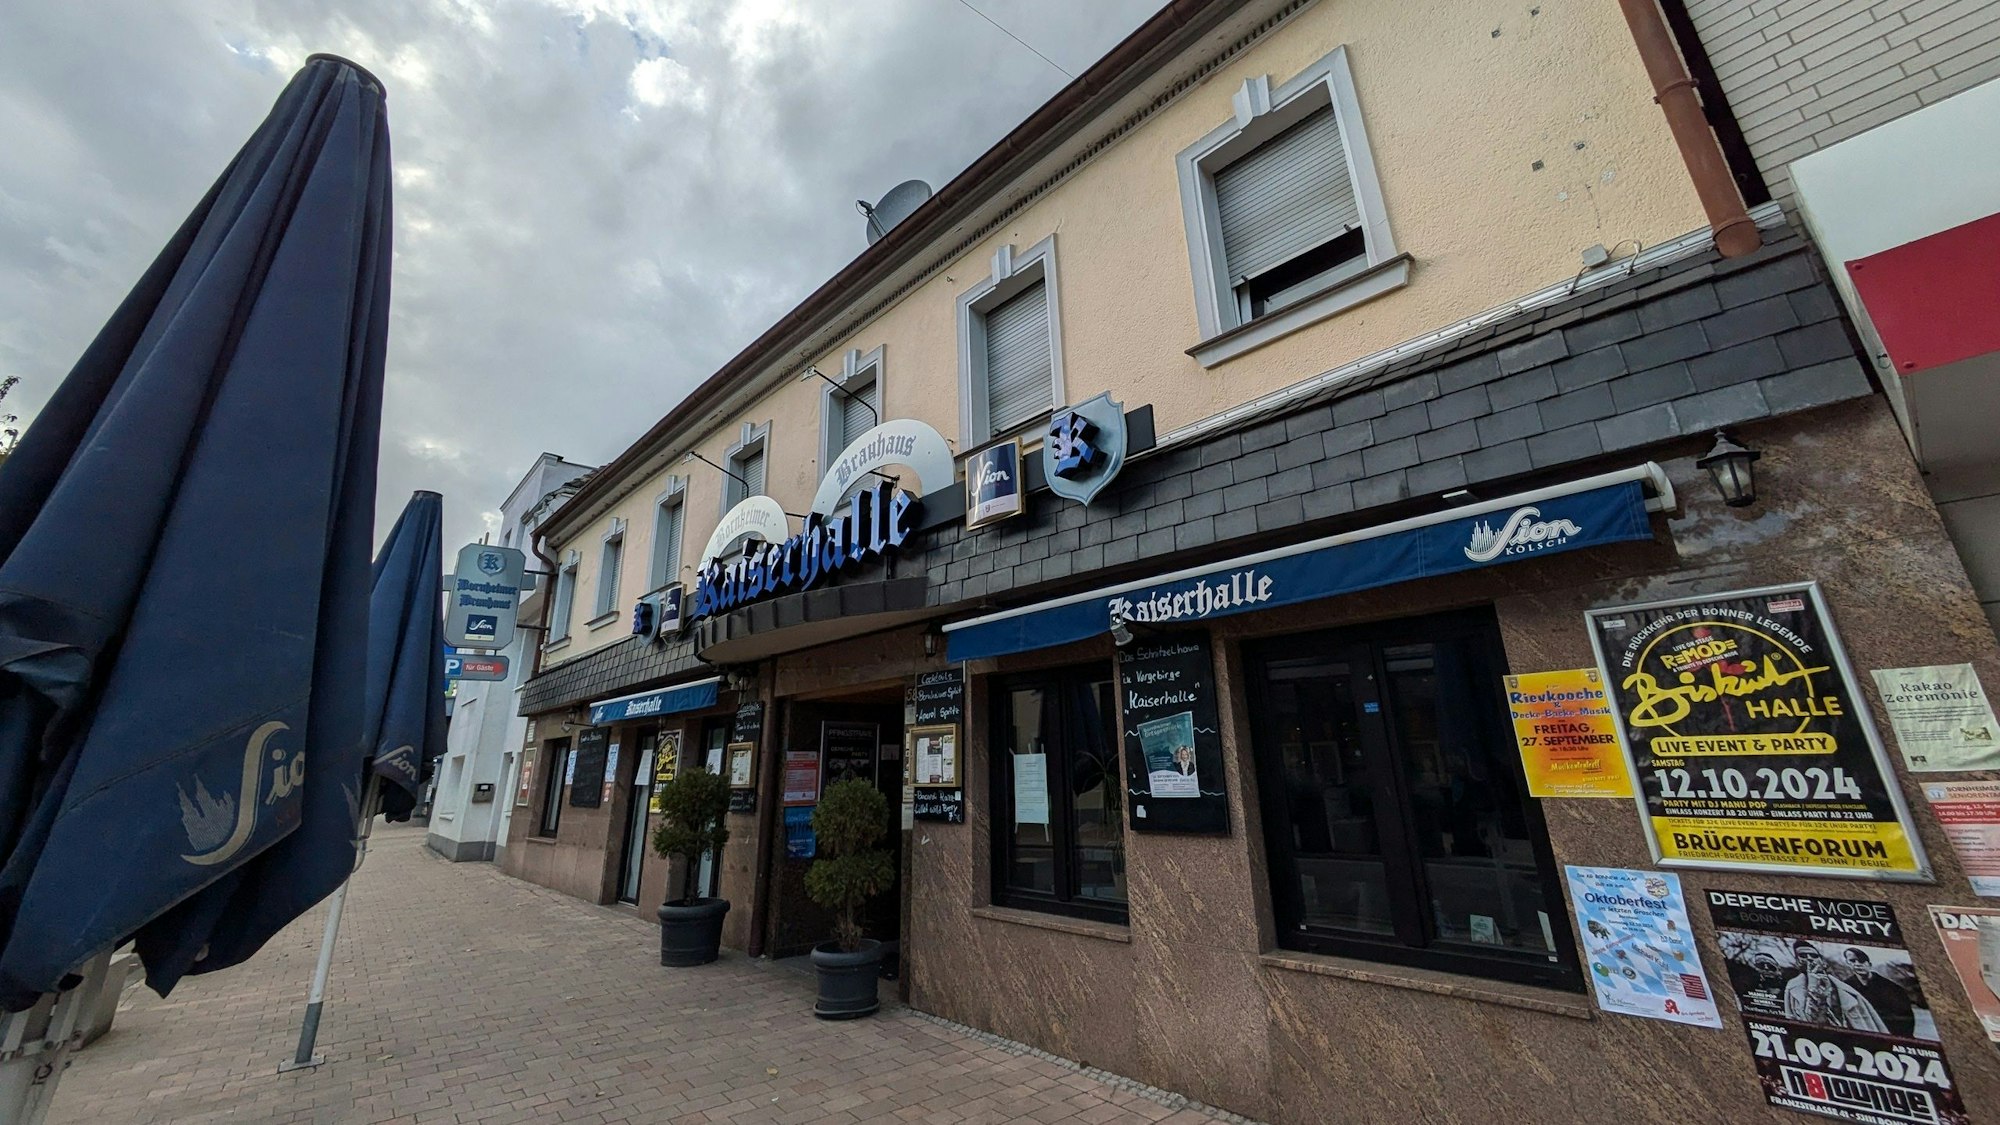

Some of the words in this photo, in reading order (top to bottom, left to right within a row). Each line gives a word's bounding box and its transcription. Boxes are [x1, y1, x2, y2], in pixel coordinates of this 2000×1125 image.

[835, 432, 916, 492] Brauhaus
[971, 461, 1011, 497] Sion
[714, 504, 771, 549] Bornheimer
[1464, 506, 1582, 562] Sion
[692, 481, 915, 621] Kaiserhalle
[1506, 537, 1567, 556] KÖLSCH
[457, 578, 518, 596] Bornheimer
[1108, 569, 1274, 622] Kaiserhalle
[459, 593, 512, 610] Brauhaus
[469, 619, 493, 631] Sion
[1622, 650, 1634, 668] DIE
[1630, 614, 1675, 652] RÜCKKEHR
[1675, 609, 1699, 620] DER
[1701, 607, 1754, 622] BONNER
[1756, 616, 1814, 654] LEGENDE
[1672, 644, 1685, 652] LIVE
[1695, 635, 1714, 645] STAGE
[1119, 650, 1134, 663] Das
[444, 659, 460, 674] P
[465, 663, 475, 671] für
[476, 663, 494, 671] Gäste
[1136, 670, 1181, 684] Vorgebirge
[1622, 654, 1830, 727] Biskuit
[1884, 689, 1979, 703] Zeremonie
[1900, 682, 1953, 692] Kakao
[1510, 688, 1604, 705] Rievkooche
[1745, 696, 1844, 719] HALLE
[1534, 722, 1595, 735] FREITAG,
[1521, 737, 1543, 747] 27.
[1543, 734, 1615, 746] SEPTEMBER
[1658, 741, 1691, 753] LIVE
[1696, 739, 1747, 752] EVENT
[1753, 739, 1767, 751] &
[1772, 738, 1828, 751] PARTY
[372, 745, 418, 782] Sion
[1651, 759, 1685, 768] SAMSTAG
[1654, 767, 1863, 800] 12.10.2024
[1663, 800, 1688, 808] PARTY
[1691, 801, 1707, 809] MIT
[1708, 801, 1719, 809] DJ
[1720, 801, 1747, 809] MANU
[1749, 801, 1768, 809] POP
[1665, 808, 1693, 816] EINLASS
[1694, 808, 1725, 816] KONZERT
[1738, 809, 1748, 817] 20
[1770, 810, 1802, 818] EINLASS
[1830, 811, 1842, 819] AB
[1855, 812, 1874, 820] UHR
[1673, 830, 1888, 858] BRÜCKENFORUM
[1678, 850, 1797, 863] FRIEDRICH-BREUER-STRASSE
[1820, 857, 1848, 865] BONN
[1860, 859, 1892, 868] BEUEL
[1585, 892, 1670, 910] Oktoberfest
[1709, 892, 1815, 913] DEPECHE
[1817, 901, 1892, 920] MODE
[1634, 908, 1665, 918] Groschen
[1739, 911, 1781, 925] BONN
[1809, 915, 1893, 937] PARTY
[1749, 1022, 1788, 1035] SAMSTAG
[1750, 1030, 1951, 1090] 21.09.2024
[1892, 1045, 1906, 1054] AB
[1906, 1047, 1915, 1055] 21
[1916, 1048, 1939, 1059] UHR
[1769, 1096, 1839, 1117] FRANZSTRASSE
